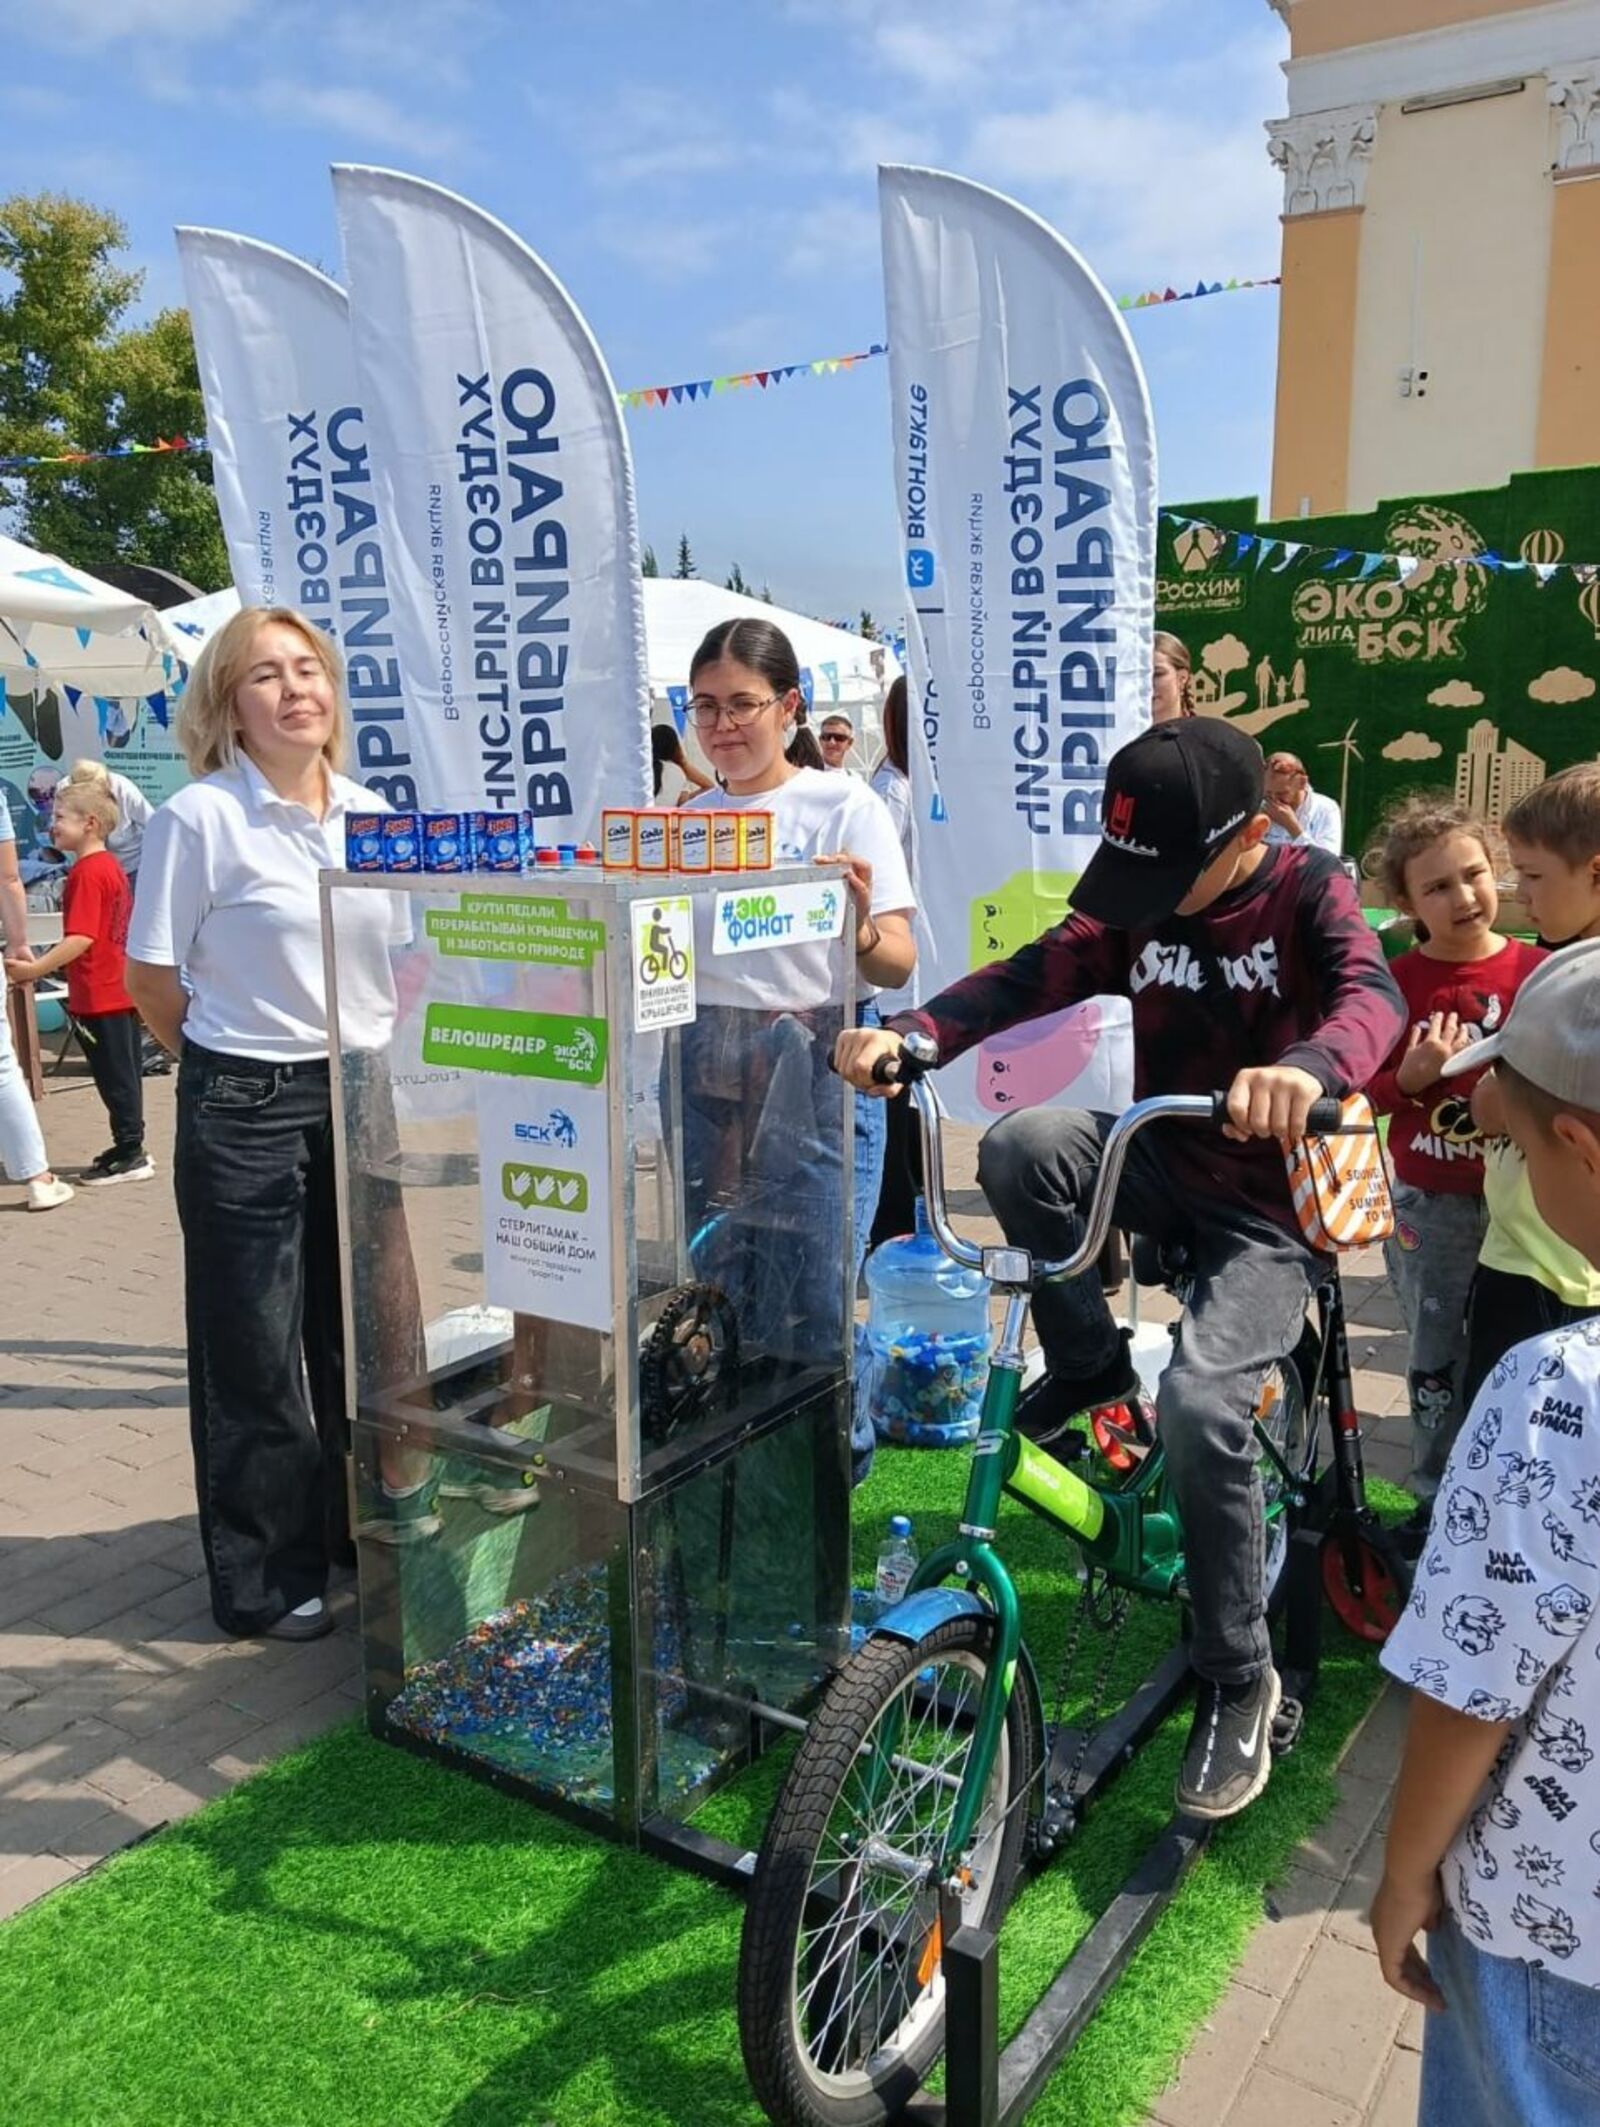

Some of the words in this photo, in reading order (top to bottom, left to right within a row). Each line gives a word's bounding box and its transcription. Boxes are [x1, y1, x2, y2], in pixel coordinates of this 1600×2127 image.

[1156, 578, 1240, 600] РОСХИМ
[1297, 580, 1403, 622] ЭКО
[1301, 624, 1356, 641] ЛИГА
[1358, 617, 1458, 660] БСК
[467, 903, 506, 916] КРУТИ
[527, 925, 600, 943] КРЫШЕЧКИ
[727, 914, 794, 946] фанат
[446, 938, 456, 949] И
[457, 939, 515, 954] ЗАБОТЬСЯ
[528, 944, 585, 960] ПРИРОДЕ
[431, 1027, 547, 1055] ВЕЛОШРЕДЕР
[553, 1044, 579, 1058] ЭКО
[568, 1058, 593, 1072] БСК
[514, 1123, 550, 1141] БСК
[499, 1217, 579, 1241] СТЕРЛИТАМАК
[496, 1232, 521, 1246] НАШ
[523, 1238, 566, 1255] ОБЩИЙ
[567, 1246, 597, 1260] ДОМ
[1542, 1396, 1584, 1422] ВЛАД
[1529, 1410, 1583, 1439] БУМАГА
[1488, 1548, 1526, 1567] ВЛАД
